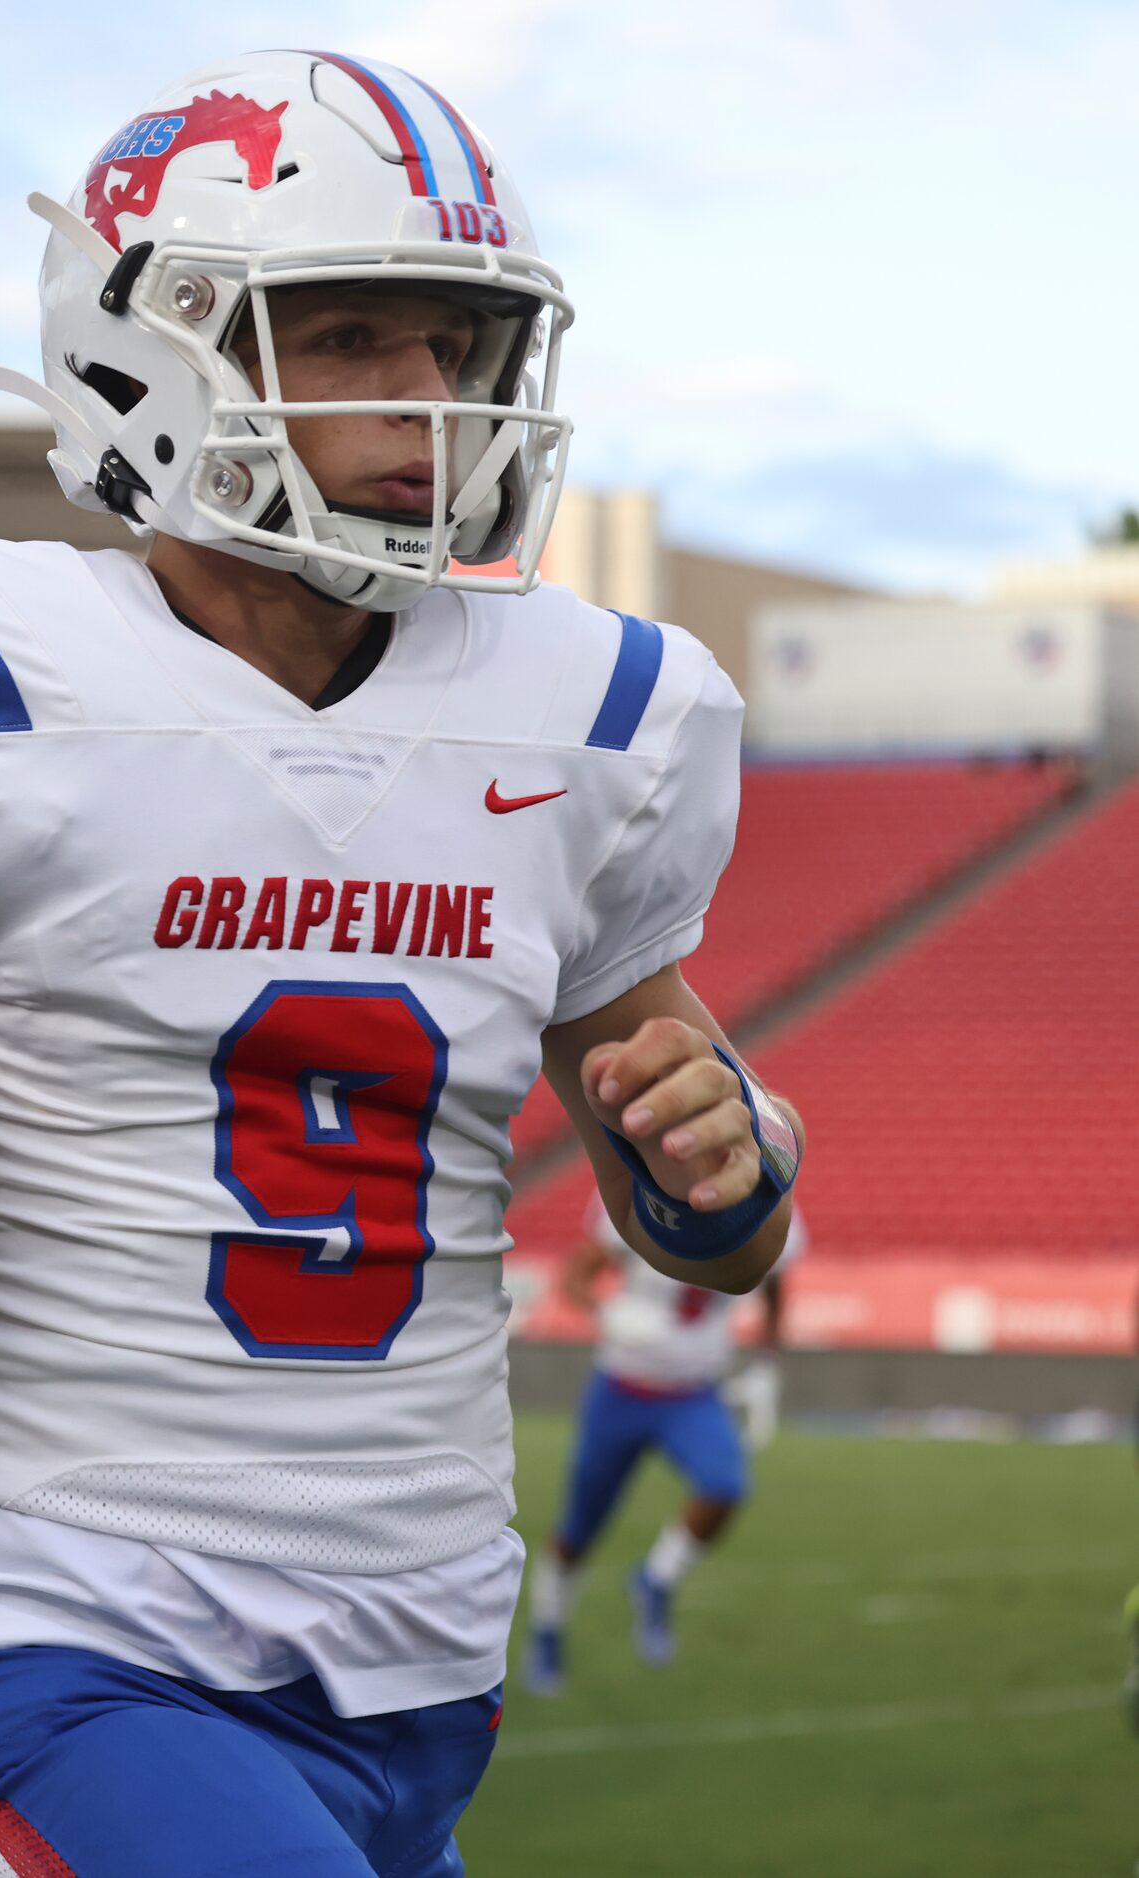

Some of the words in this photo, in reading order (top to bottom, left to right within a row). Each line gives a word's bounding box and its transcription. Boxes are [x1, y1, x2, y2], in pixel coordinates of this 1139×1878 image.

[100, 116, 186, 165] GHS
[428, 200, 508, 248] 103
[153, 876, 494, 959] GRAPEVINE
[205, 980, 449, 1360] 9
